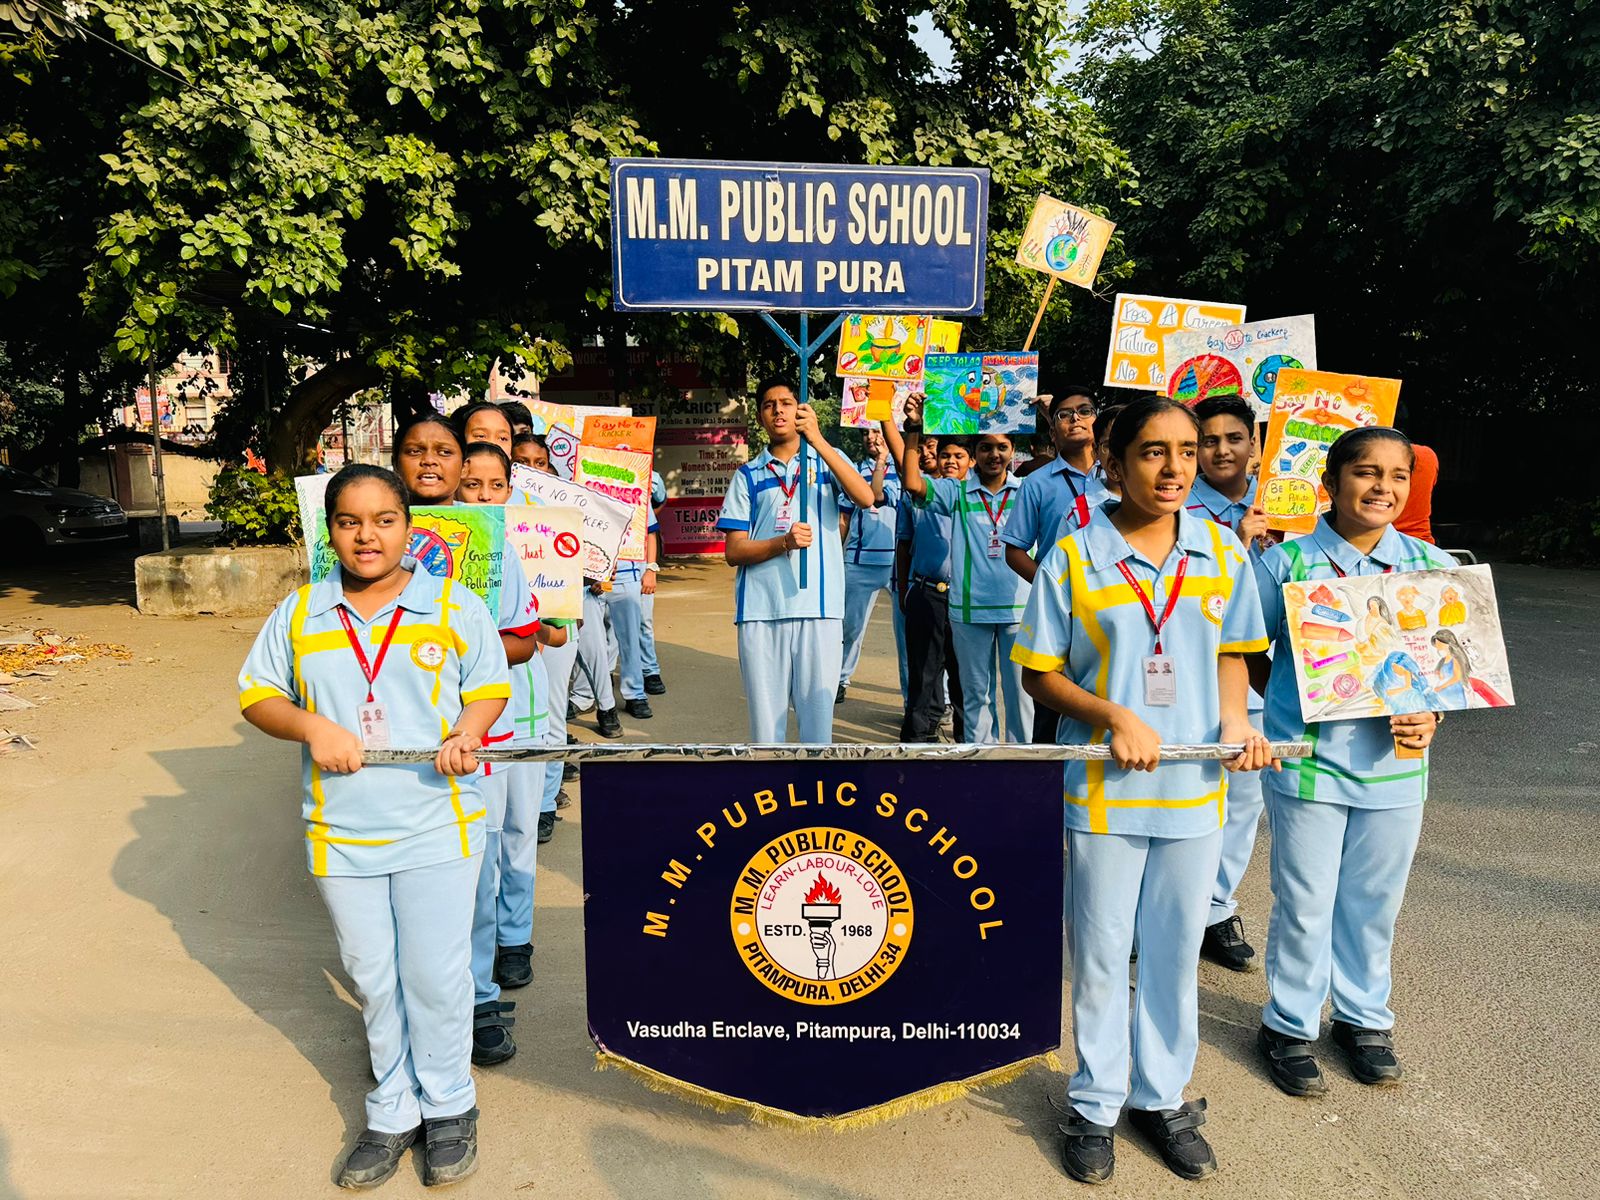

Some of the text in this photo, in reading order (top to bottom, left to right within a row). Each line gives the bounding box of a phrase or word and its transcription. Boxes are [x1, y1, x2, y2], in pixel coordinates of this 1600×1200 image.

[626, 177, 972, 246] M.M. PUBLIC SCHOOL
[697, 257, 906, 293] PITAM PURA
[1124, 302, 1229, 328] For A Green
[1119, 328, 1157, 354] Future
[1207, 335, 1224, 352] Say
[927, 356, 951, 367] DEEP
[1117, 362, 1164, 384] No to
[631, 403, 655, 415] EST
[1275, 393, 1308, 415] Say
[1314, 391, 1342, 410] No
[593, 419, 616, 430] Say
[617, 420, 631, 428] No
[717, 417, 742, 425] Space.
[699, 450, 728, 459] Time For
[681, 462, 711, 472] Women's
[715, 477, 723, 485] AM
[1270, 483, 1283, 494] BE
[520, 478, 588, 508] SAY NO TO
[685, 487, 704, 496] Evening
[583, 515, 610, 532] KERS
[469, 550, 503, 561] Green
[521, 543, 545, 560] Just
[465, 562, 503, 576] Diwali
[465, 577, 502, 590] Pollution
[528, 573, 566, 588] Abuse
[734, 831, 910, 918] M.M. PUBLIC SCHOOL
[876, 792, 1004, 941] SCHOOL
[761, 857, 884, 910] LEARN-LABOUR-LOVE
[764, 924, 873, 937] ESTD. 1968
[743, 941, 902, 1001] PITAMPURA, DELHI-34
[627, 1021, 1021, 1042] Vasudha Enclave, Pitampura, Delhi-110034
